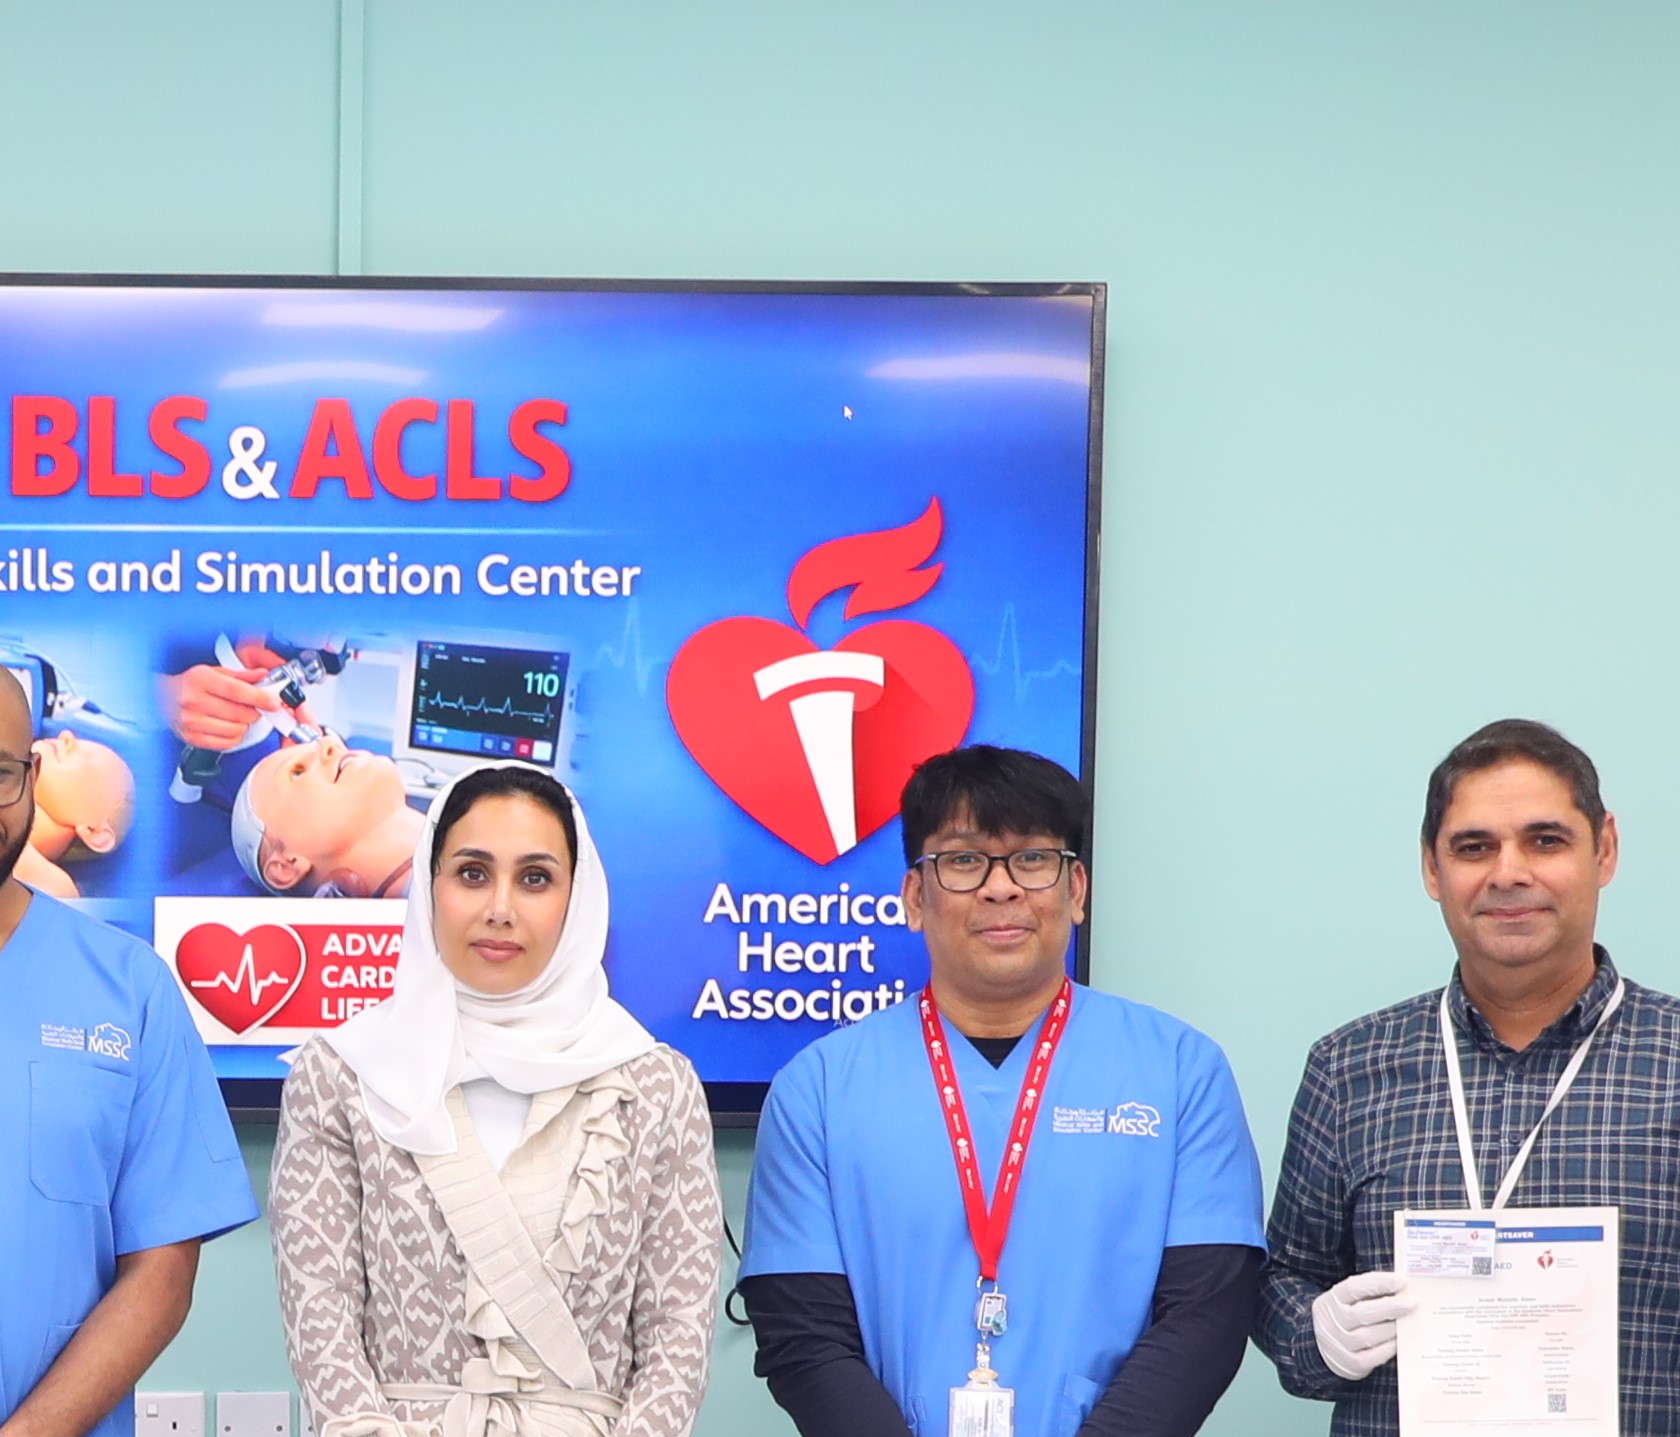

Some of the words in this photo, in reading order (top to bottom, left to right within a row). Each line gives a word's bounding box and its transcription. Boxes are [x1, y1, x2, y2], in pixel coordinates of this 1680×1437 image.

[11, 397, 212, 499] BLS
[222, 425, 280, 500] &
[290, 399, 572, 502] ACLS
[87, 549, 181, 593] and
[196, 551, 461, 595] Simulation
[477, 554, 642, 597] Center
[524, 671, 560, 698] 110
[703, 882, 907, 926] America
[322, 932, 402, 956] ADVA
[738, 931, 876, 973] Heart
[321, 965, 396, 989] CARD
[692, 978, 905, 1021] Associati
